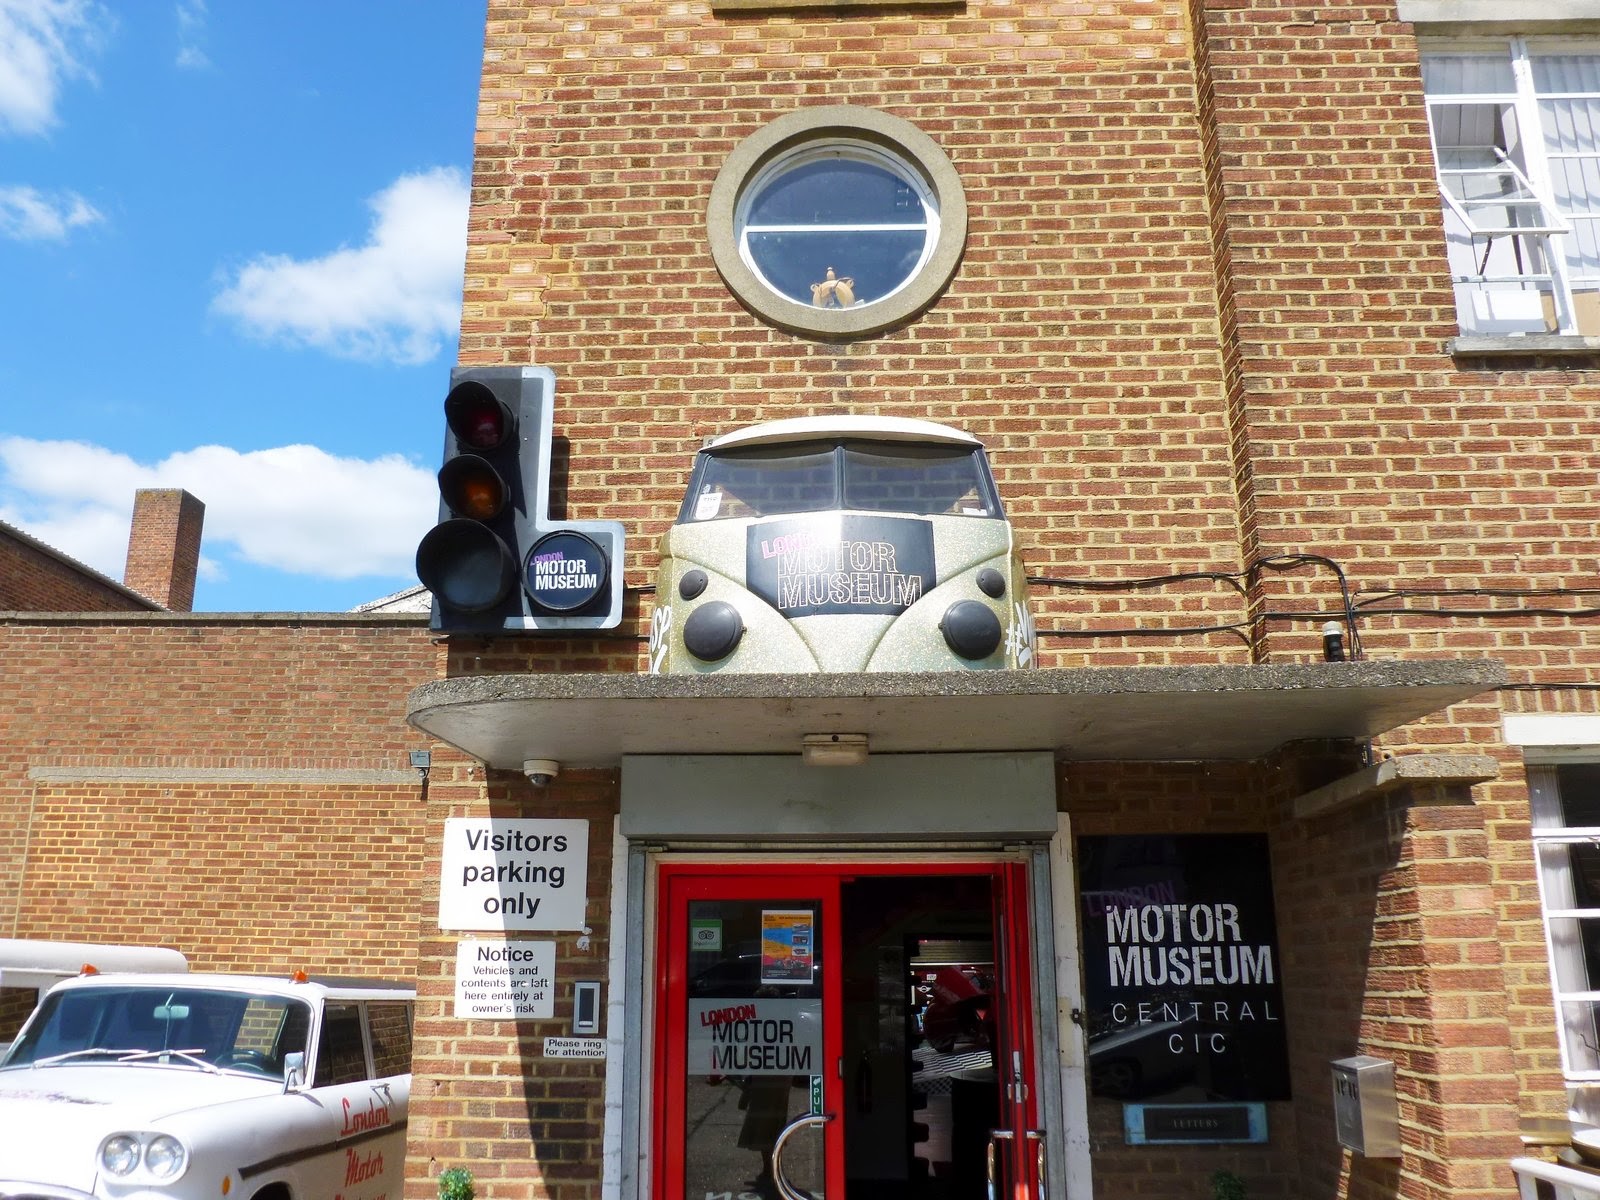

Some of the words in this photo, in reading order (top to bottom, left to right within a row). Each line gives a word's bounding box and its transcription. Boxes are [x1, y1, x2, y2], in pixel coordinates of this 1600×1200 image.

[530, 552, 564, 566] LONDON
[536, 559, 587, 575] MOTOR
[778, 541, 898, 576] MOTOR
[535, 574, 597, 590] MUSEUM
[778, 572, 922, 609] MUSEUM
[466, 829, 568, 852] Visitors
[463, 861, 565, 888] parking
[484, 892, 541, 919] only
[1106, 903, 1242, 943] MOTOR
[477, 946, 534, 962] Notice
[473, 966, 515, 975] Vehicles
[518, 966, 538, 975] and
[1108, 945, 1274, 987] MUSEUM
[461, 979, 506, 988] contents
[464, 992, 487, 1000] here
[491, 992, 529, 1002] entirely
[533, 992, 544, 1000] at
[472, 1004, 512, 1013] owner's
[516, 1004, 535, 1013] risk
[700, 1003, 757, 1027] LONDON
[1112, 1001, 1279, 1023] CENTRAL
[712, 1019, 794, 1043] MOTOR
[545, 1048, 560, 1056] for
[562, 1048, 605, 1056] attention
[548, 1039, 580, 1047] Please
[583, 1039, 602, 1049] ring
[1168, 1033, 1226, 1054] CIC
[712, 1045, 811, 1070] MUSEUM
[813, 1088, 821, 1114] PUL
[340, 1097, 391, 1137] London
[344, 1147, 385, 1188] Motor
